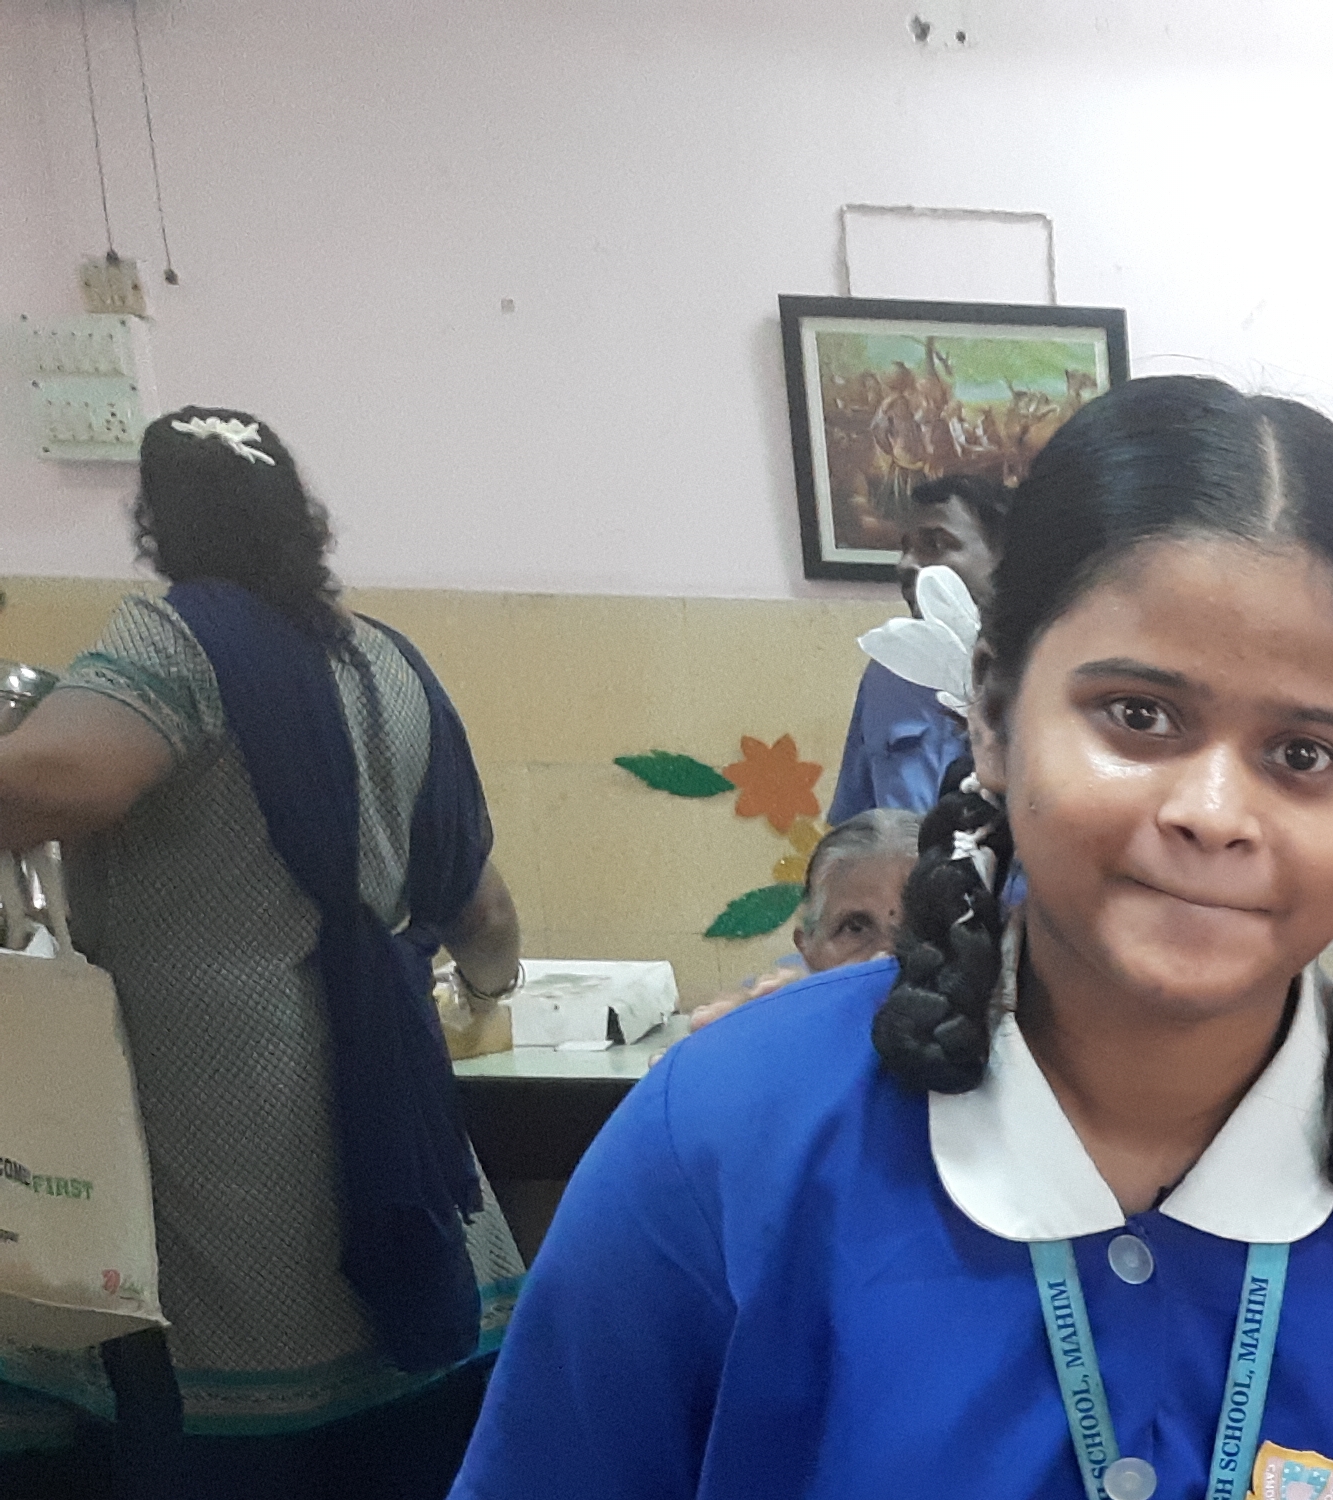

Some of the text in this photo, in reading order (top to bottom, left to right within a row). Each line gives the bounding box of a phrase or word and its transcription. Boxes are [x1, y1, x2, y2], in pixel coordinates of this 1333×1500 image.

[1047, 1279, 1086, 1370] MAHIM
[1237, 1276, 1269, 1364] MAHIM
[1219, 1370, 1256, 1472] SCHOOL,
